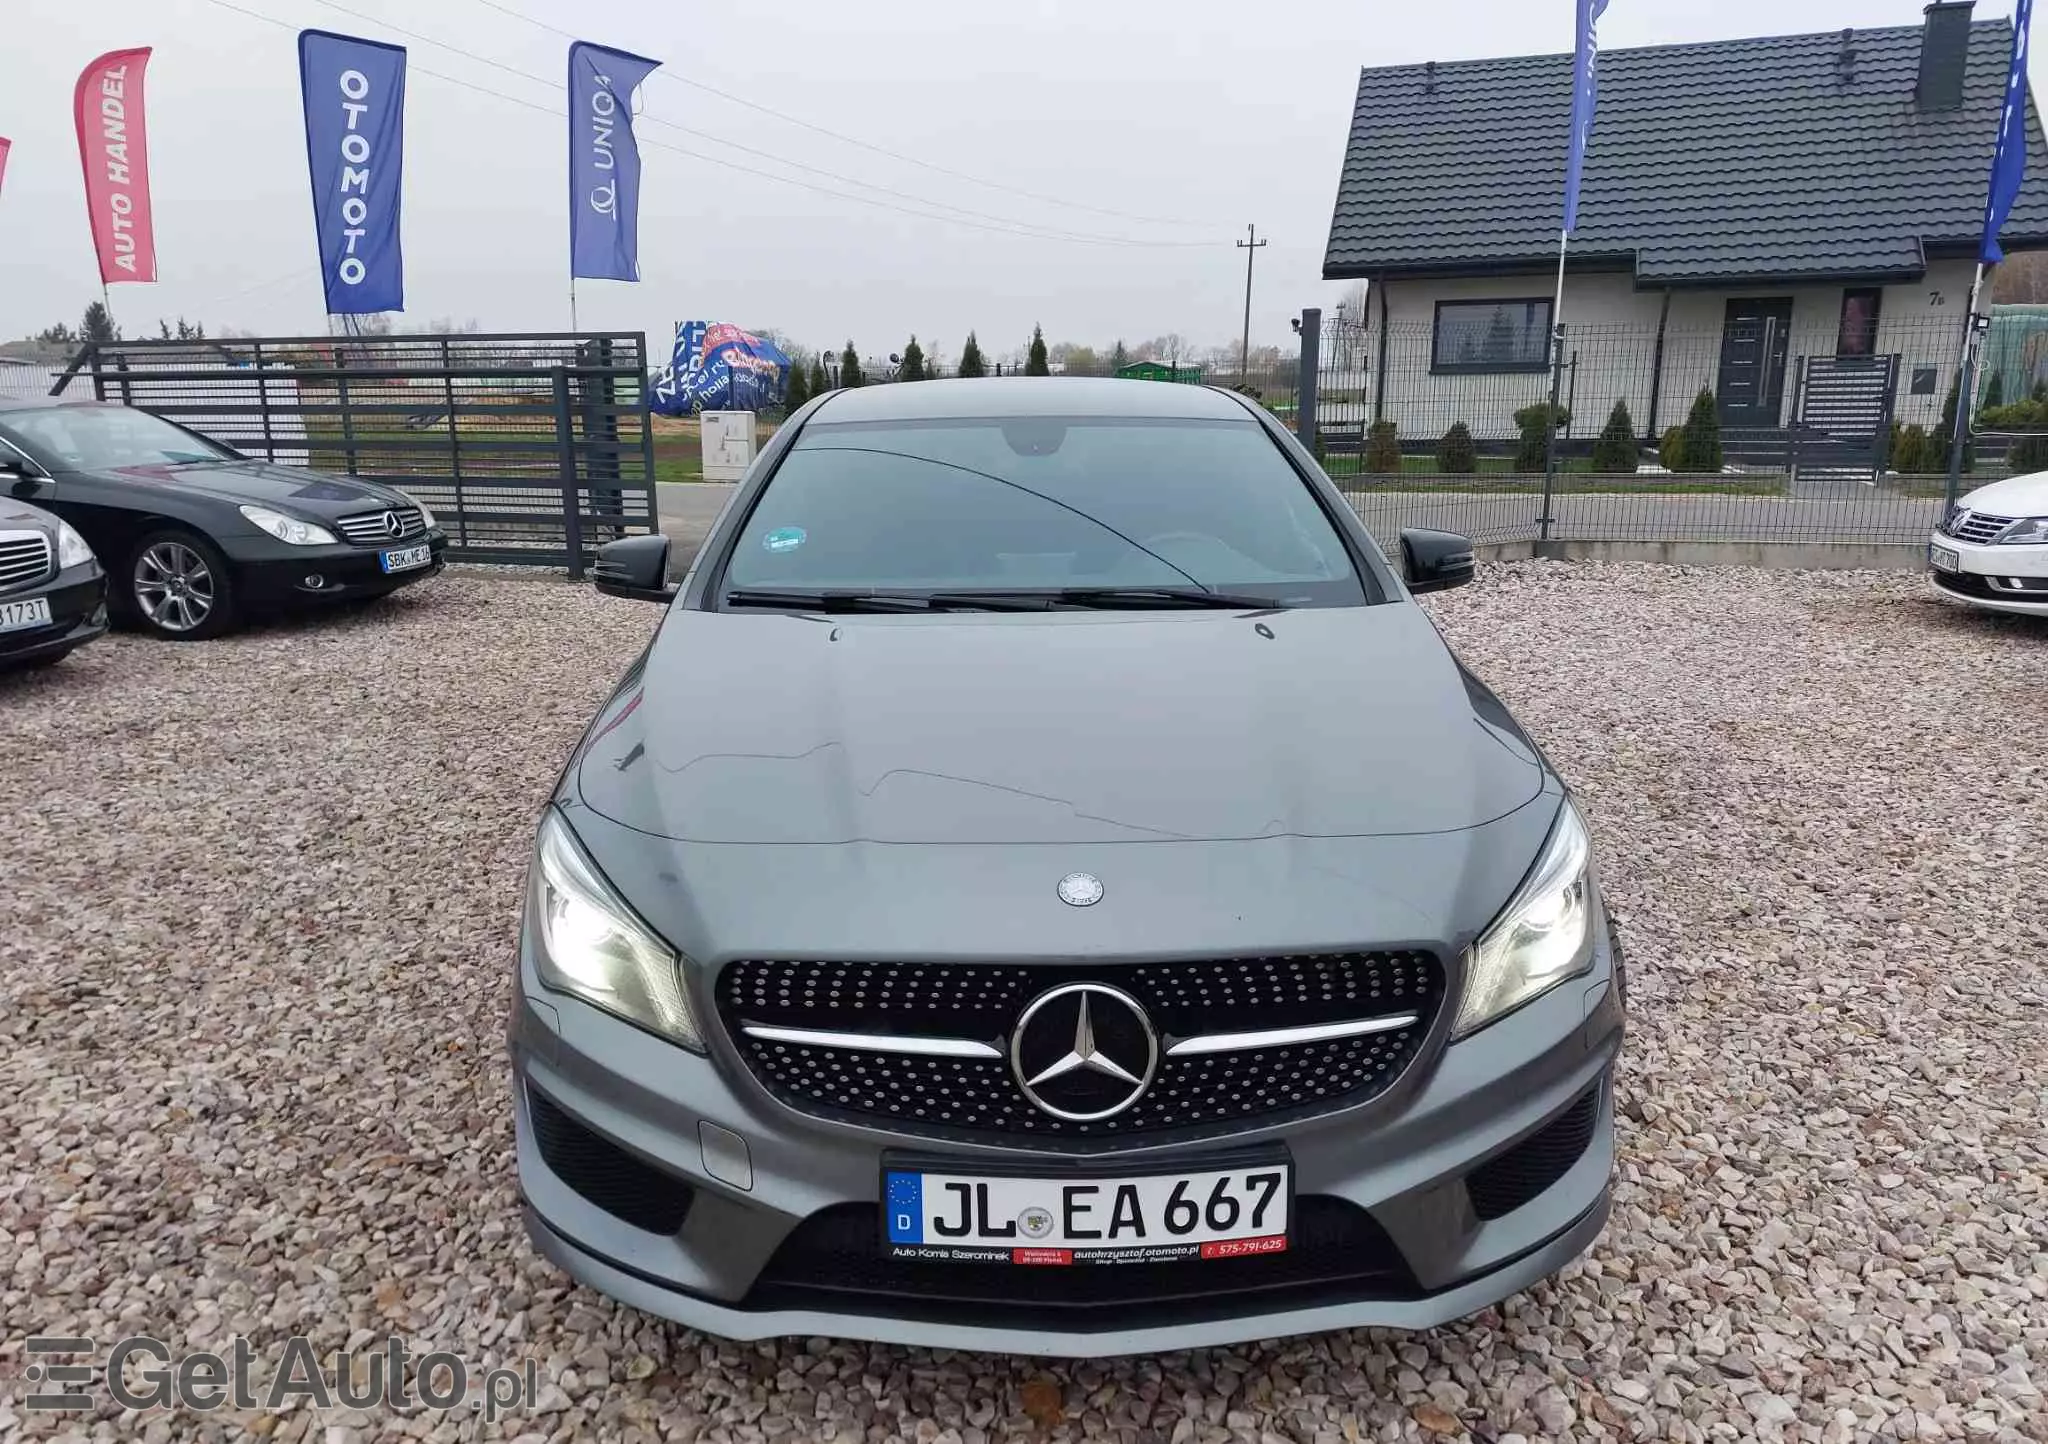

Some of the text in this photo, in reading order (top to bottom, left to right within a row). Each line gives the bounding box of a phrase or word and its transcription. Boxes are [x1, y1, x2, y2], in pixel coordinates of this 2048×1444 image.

[102, 64, 136, 273] AUTO HANDEL
[339, 69, 370, 285] OTOMOTO
[897, 1215, 911, 1231] D
[933, 1172, 1282, 1240] JL EA 667
[892, 1247, 916, 1257] Auto
[1073, 1244, 1200, 1260] autokrzysztof.otomoto.pl
